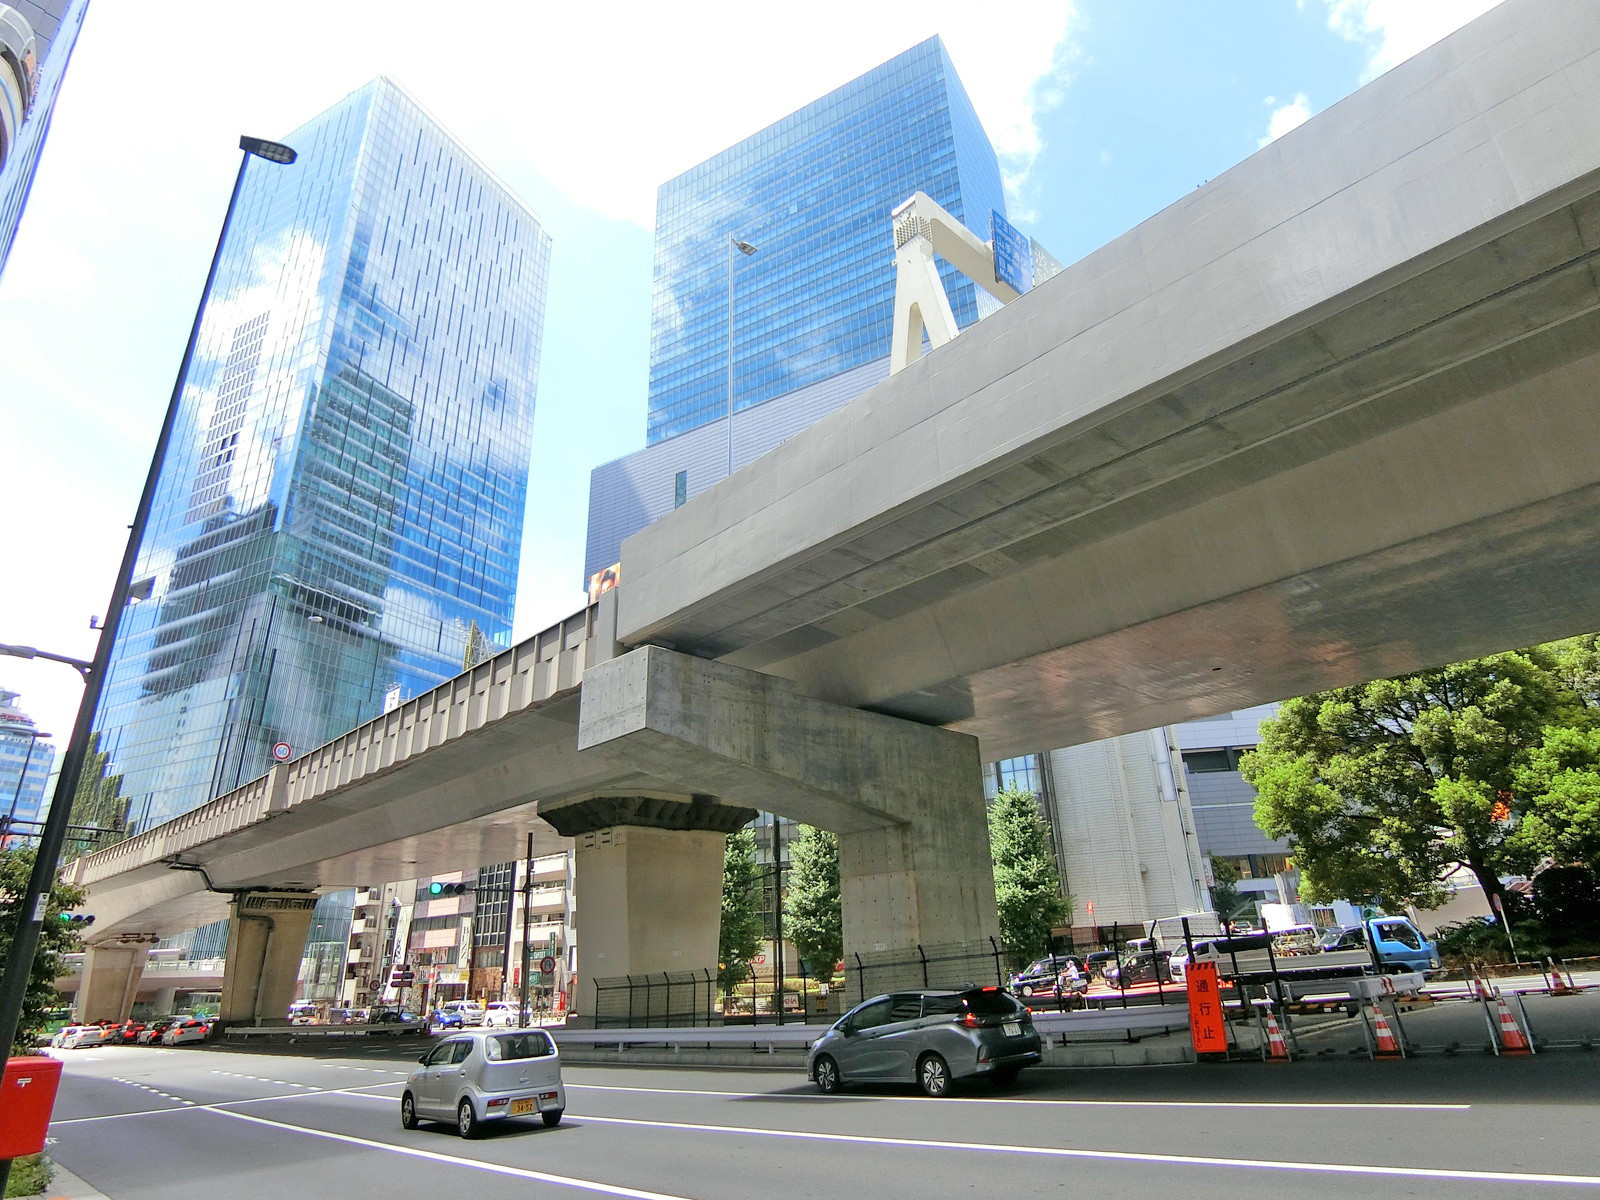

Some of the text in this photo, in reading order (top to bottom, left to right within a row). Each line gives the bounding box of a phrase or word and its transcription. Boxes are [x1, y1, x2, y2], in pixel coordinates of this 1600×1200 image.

[277, 746, 288, 756] 60
[1196, 979, 1215, 1039] 通行止
